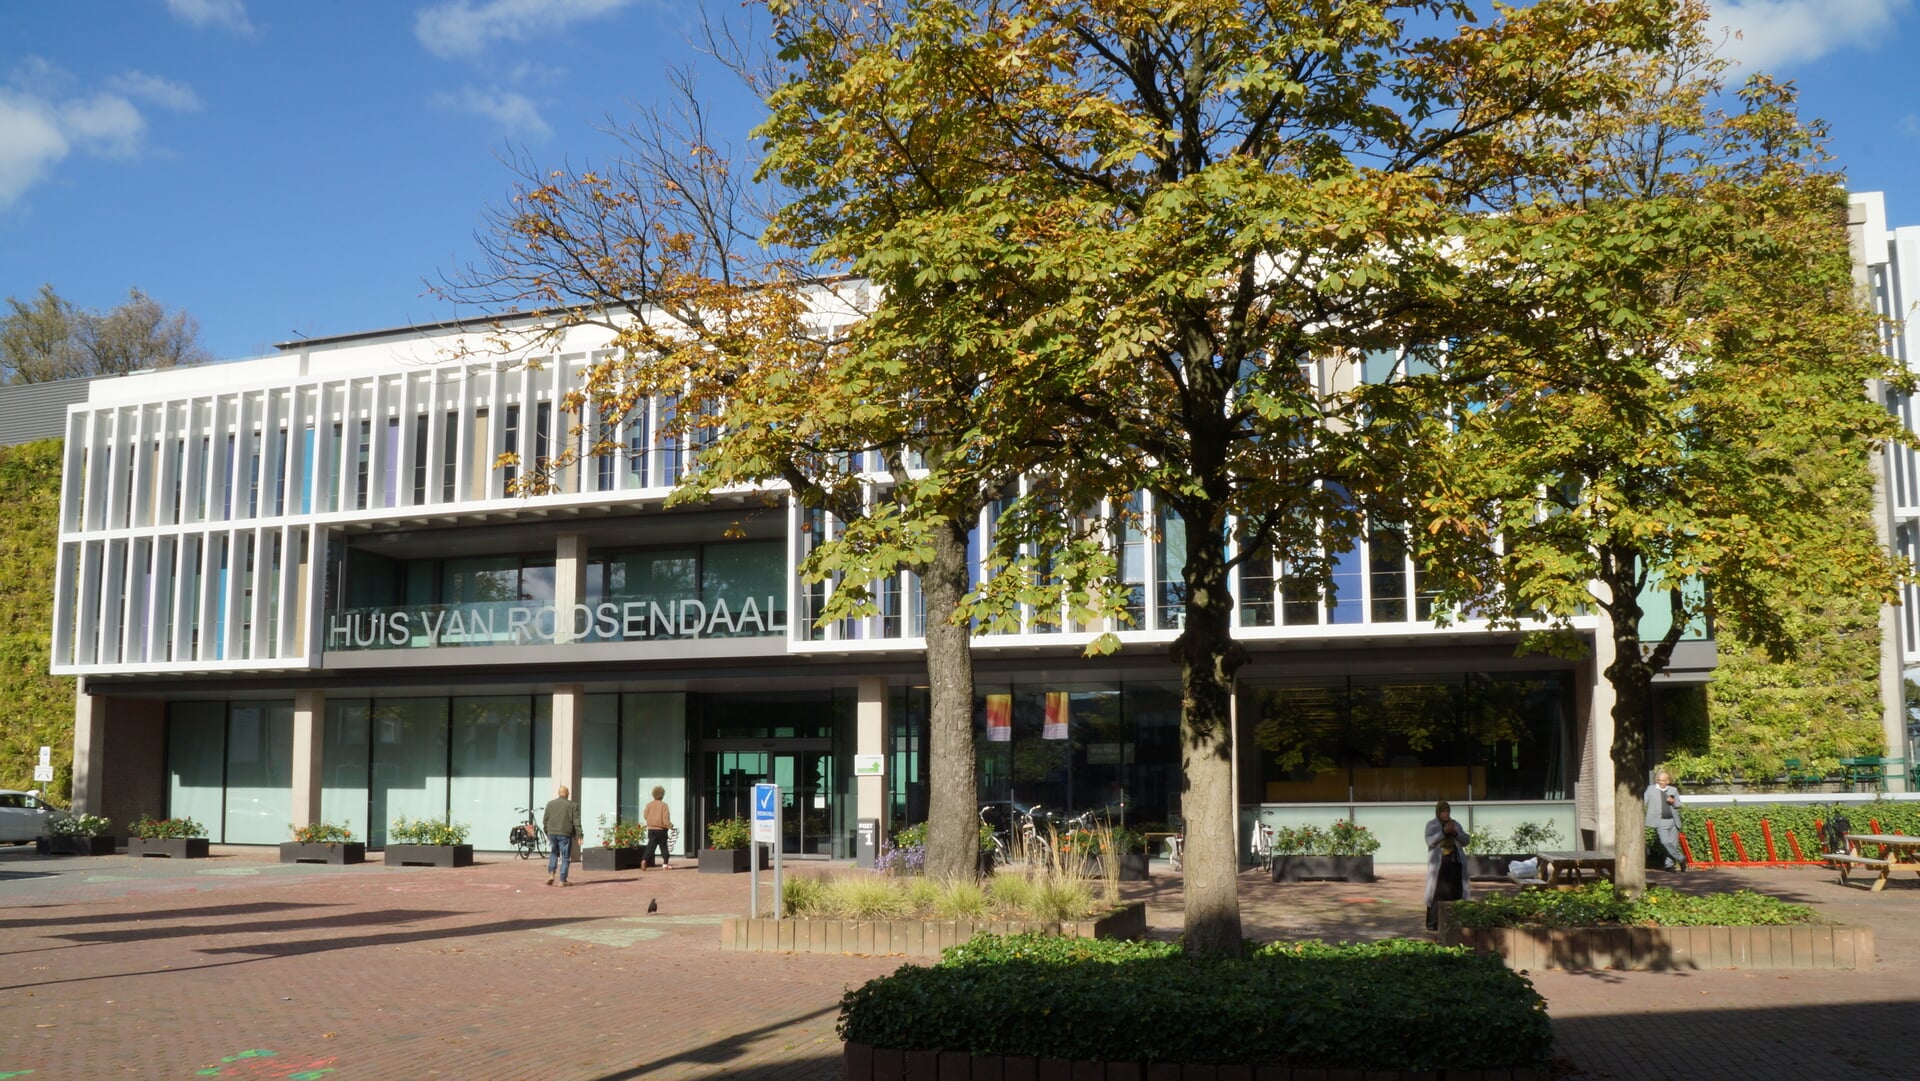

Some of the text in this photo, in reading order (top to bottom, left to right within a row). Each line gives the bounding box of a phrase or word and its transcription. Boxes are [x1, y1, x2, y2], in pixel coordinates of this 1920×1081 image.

[329, 596, 788, 647] HUIS VAN ROOSENDAAL
[865, 833, 873, 846] 1
